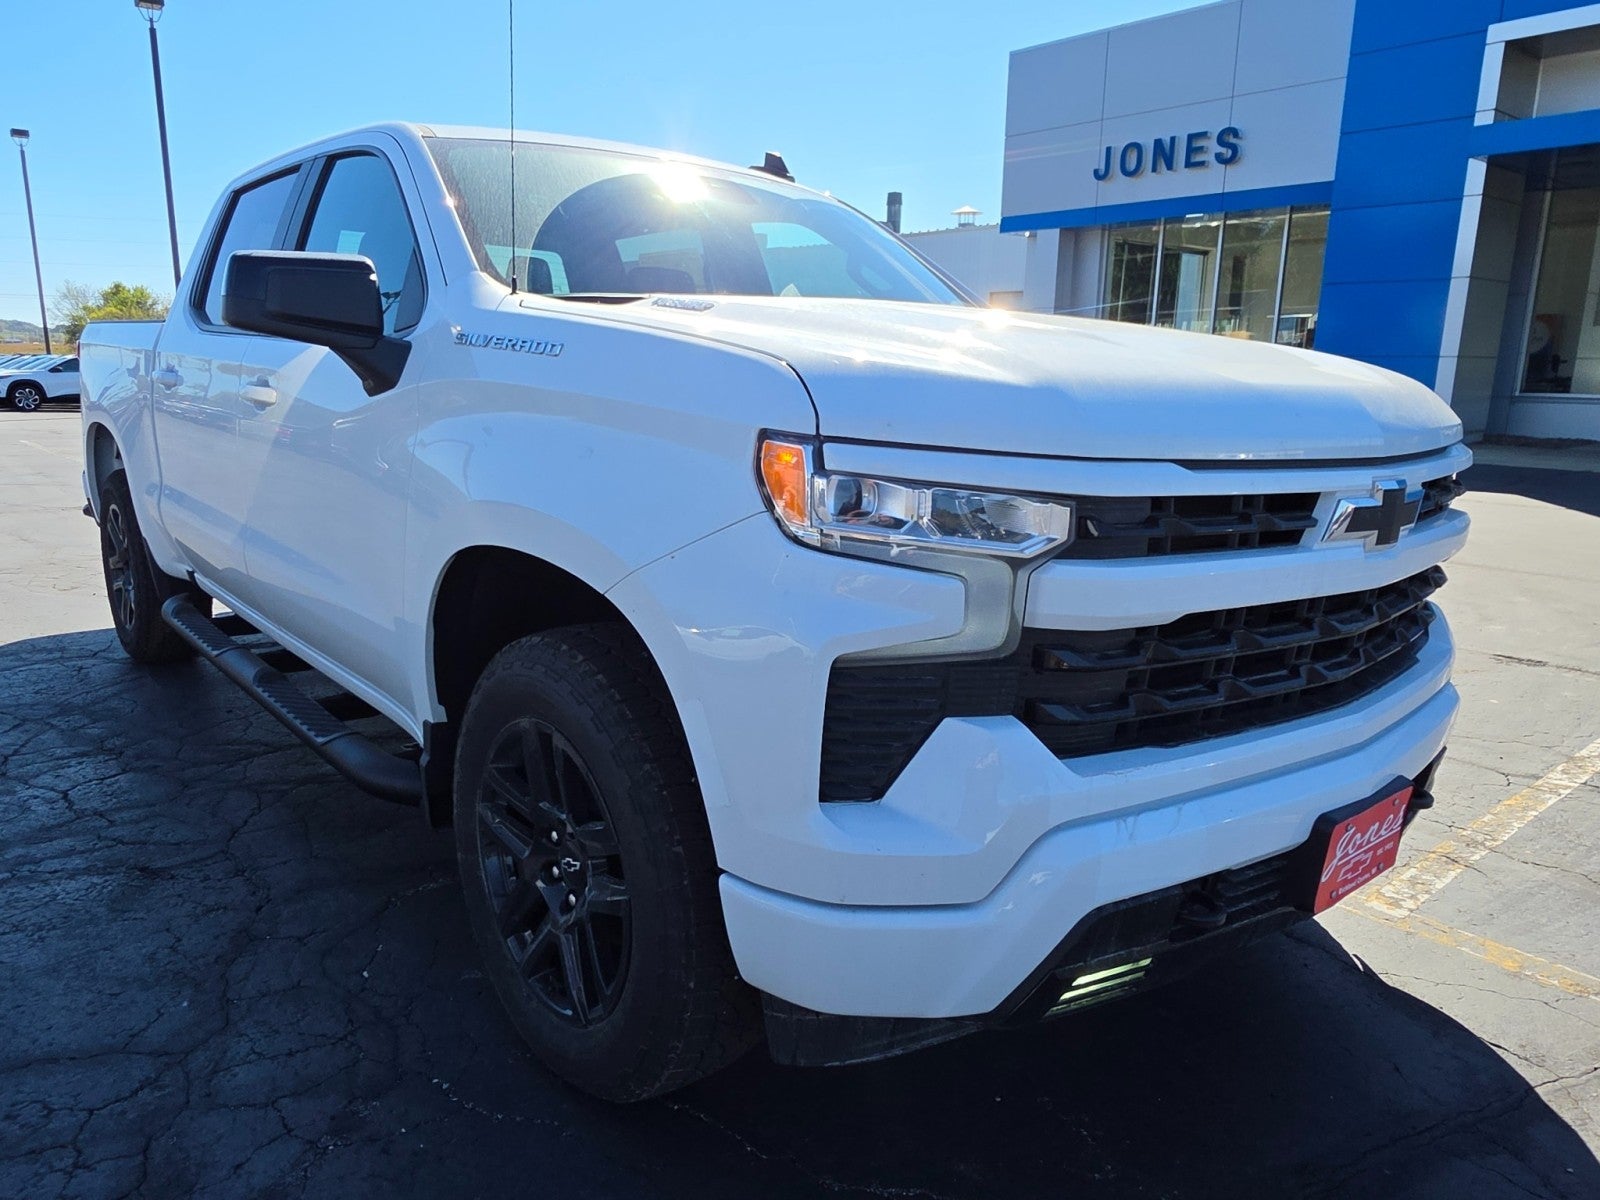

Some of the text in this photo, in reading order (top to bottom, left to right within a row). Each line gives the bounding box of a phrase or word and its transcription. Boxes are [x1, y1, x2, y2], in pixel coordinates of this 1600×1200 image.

[1093, 126, 1242, 181] JONES
[454, 331, 564, 357] SILVERADO
[1321, 804, 1406, 883] Jones
